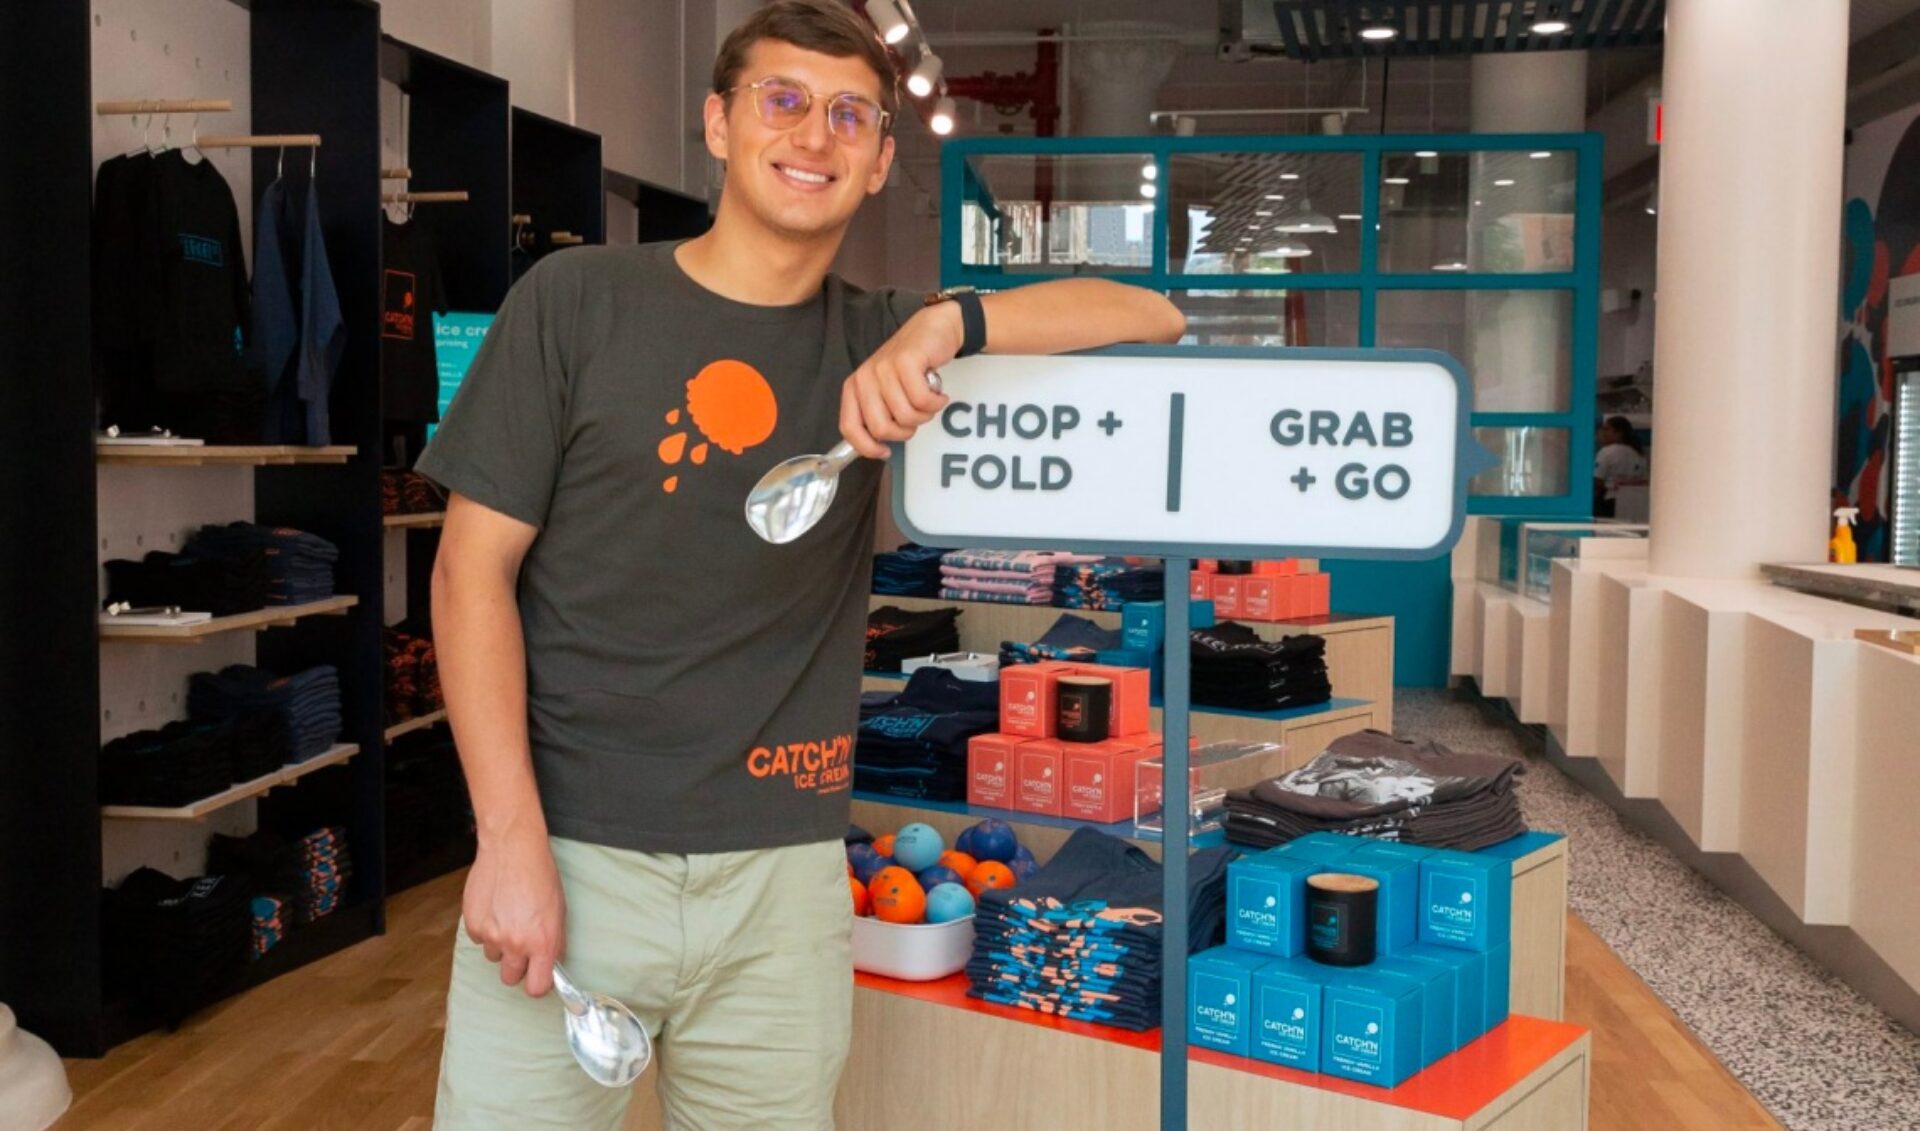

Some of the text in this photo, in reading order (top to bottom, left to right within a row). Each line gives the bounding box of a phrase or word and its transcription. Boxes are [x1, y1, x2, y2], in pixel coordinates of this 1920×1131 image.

[437, 321, 460, 336] ice
[940, 400, 1124, 440] CHOP +
[1269, 408, 1414, 447] GRAB
[940, 453, 1074, 492] FOLD
[1290, 462, 1412, 501] + GO
[794, 773, 817, 789] ICE
[1197, 1005, 1236, 1021] CATCH'N
[1264, 1019, 1304, 1036] CATCH'N
[1335, 1034, 1378, 1051] CATCH'N
